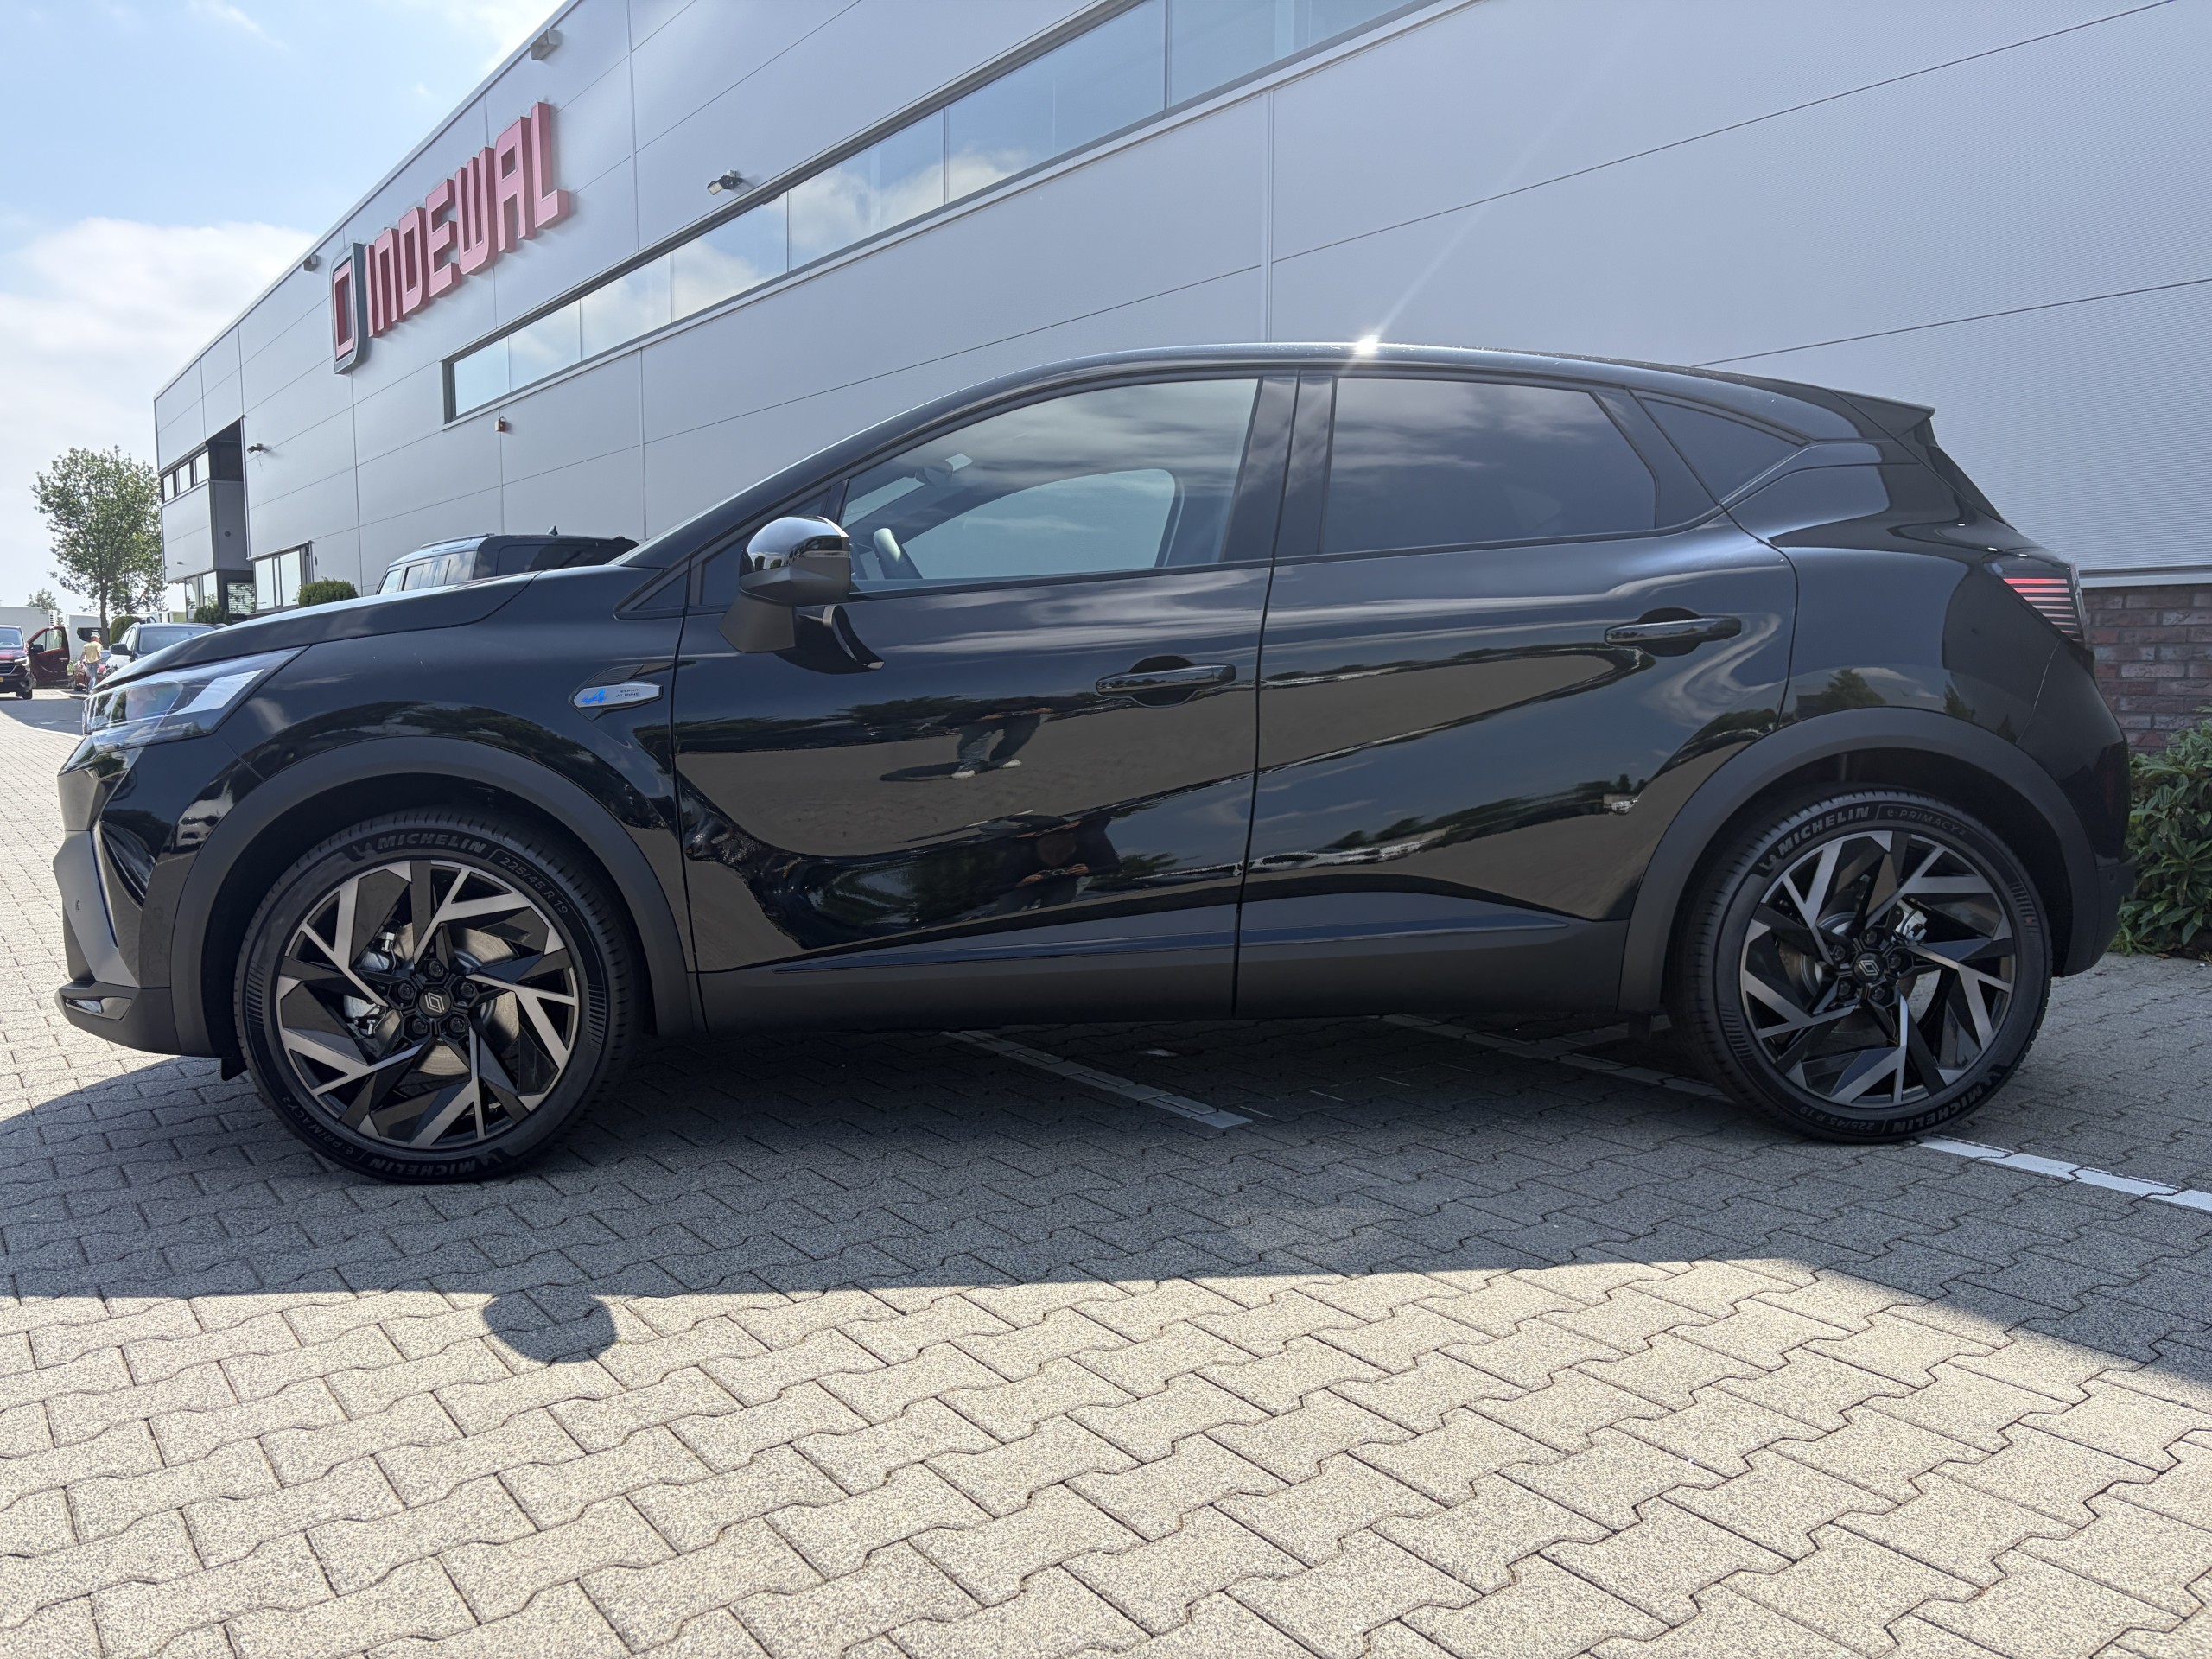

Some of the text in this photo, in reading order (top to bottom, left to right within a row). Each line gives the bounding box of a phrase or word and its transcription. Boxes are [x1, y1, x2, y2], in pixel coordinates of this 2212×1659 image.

[1777, 806, 1870, 856] MICHELIN
[378, 833, 569, 914] MICHELIN 225/45 R 19
[1827, 1116, 1875, 1131] 225/45
[1893, 1084, 1983, 1133] MICHELIN
[369, 1158, 476, 1176] MICHELIN
